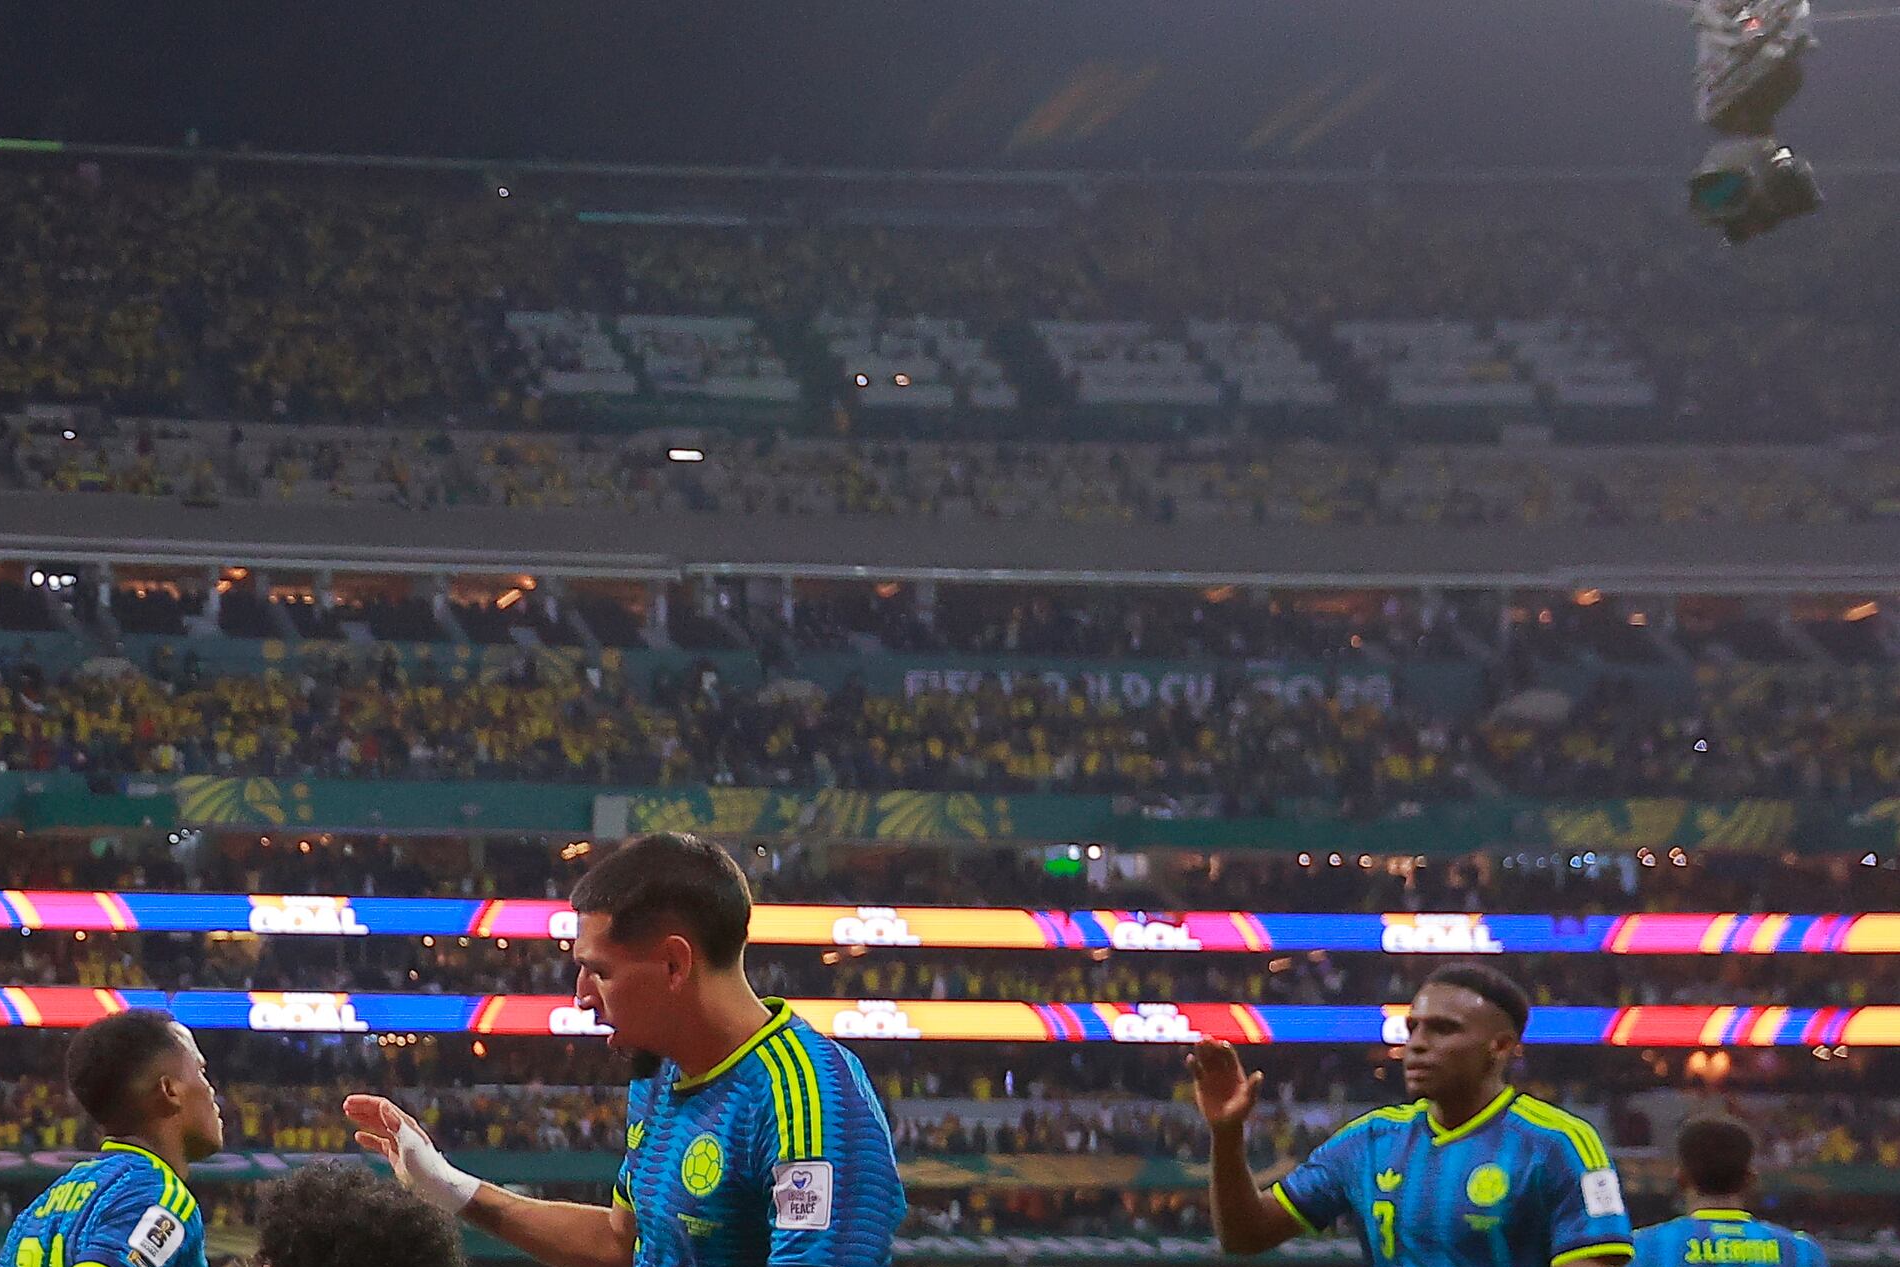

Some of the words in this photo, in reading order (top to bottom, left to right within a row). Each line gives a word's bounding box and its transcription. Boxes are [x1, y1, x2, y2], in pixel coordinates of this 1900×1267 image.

[248, 905, 370, 936] GOAL
[831, 916, 921, 947] GOL
[1111, 921, 1202, 951] GOL
[1382, 924, 1504, 953] GOAL
[248, 1002, 370, 1032] GOAL
[832, 1010, 922, 1039] GOL
[1112, 1012, 1202, 1042] GOL
